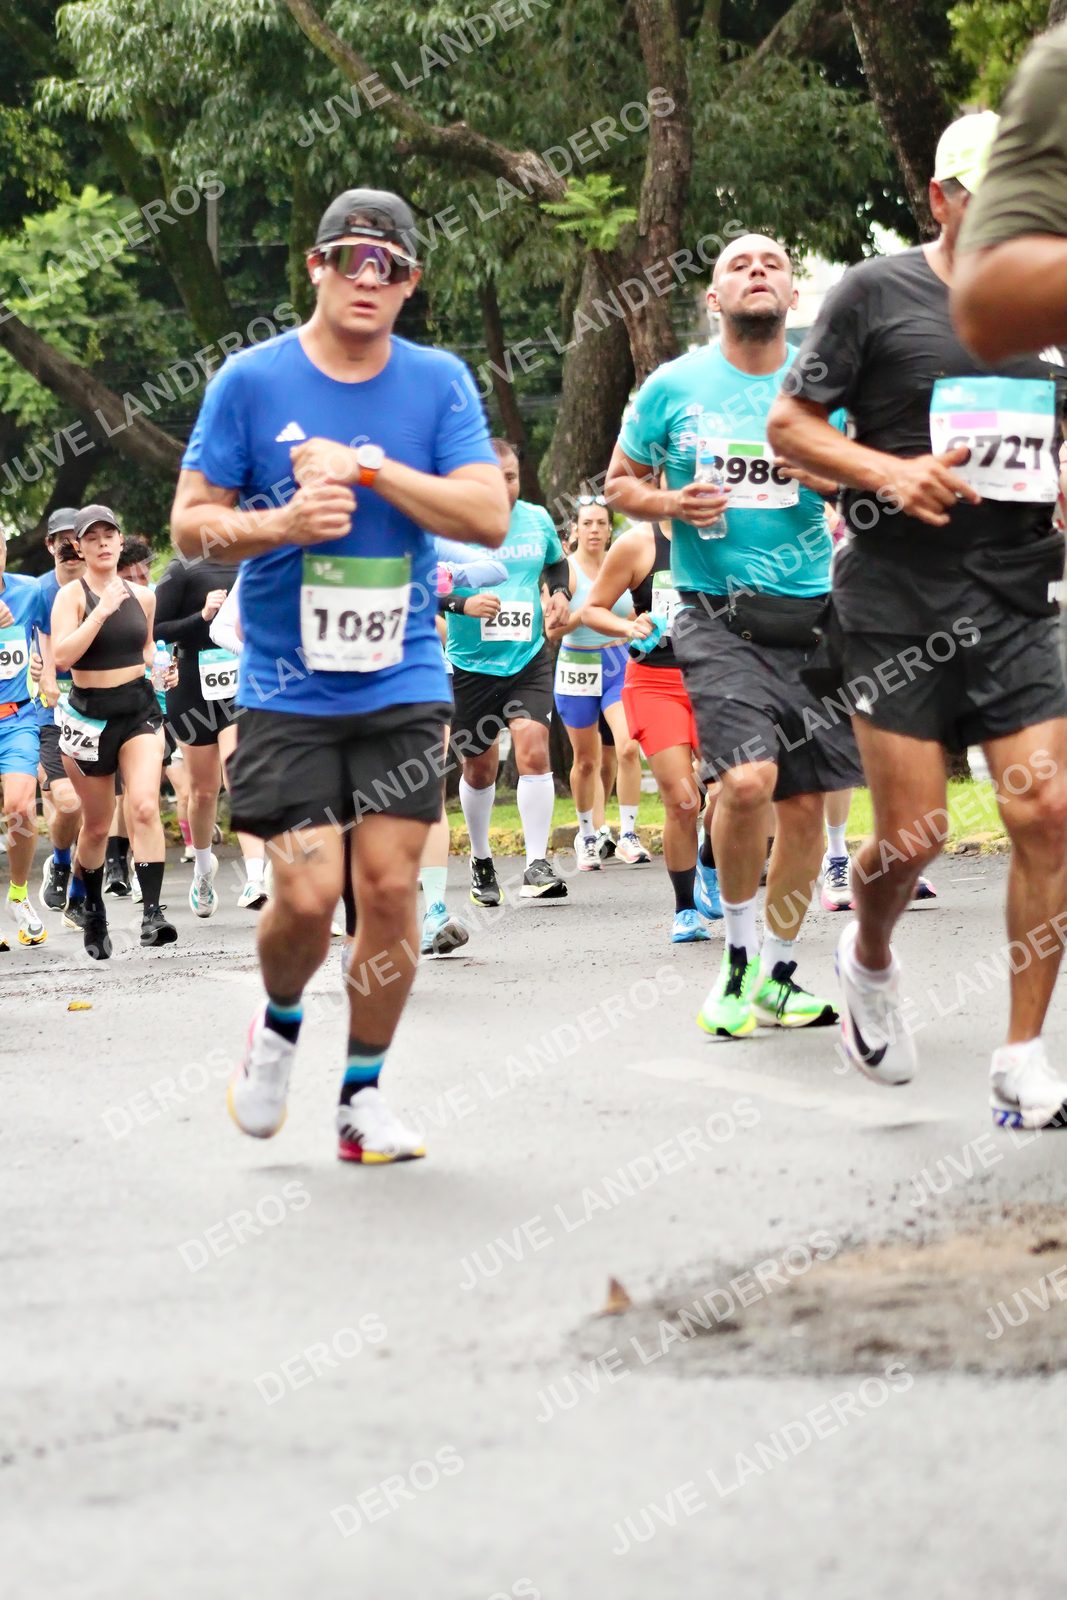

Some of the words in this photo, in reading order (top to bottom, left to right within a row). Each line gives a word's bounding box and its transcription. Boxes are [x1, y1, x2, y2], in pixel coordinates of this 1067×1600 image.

[946, 435, 1044, 470] 6727
[313, 607, 403, 642] 1087
[485, 612, 531, 627] 2636
[560, 670, 598, 686] 1587
[60, 720, 95, 749] 974
